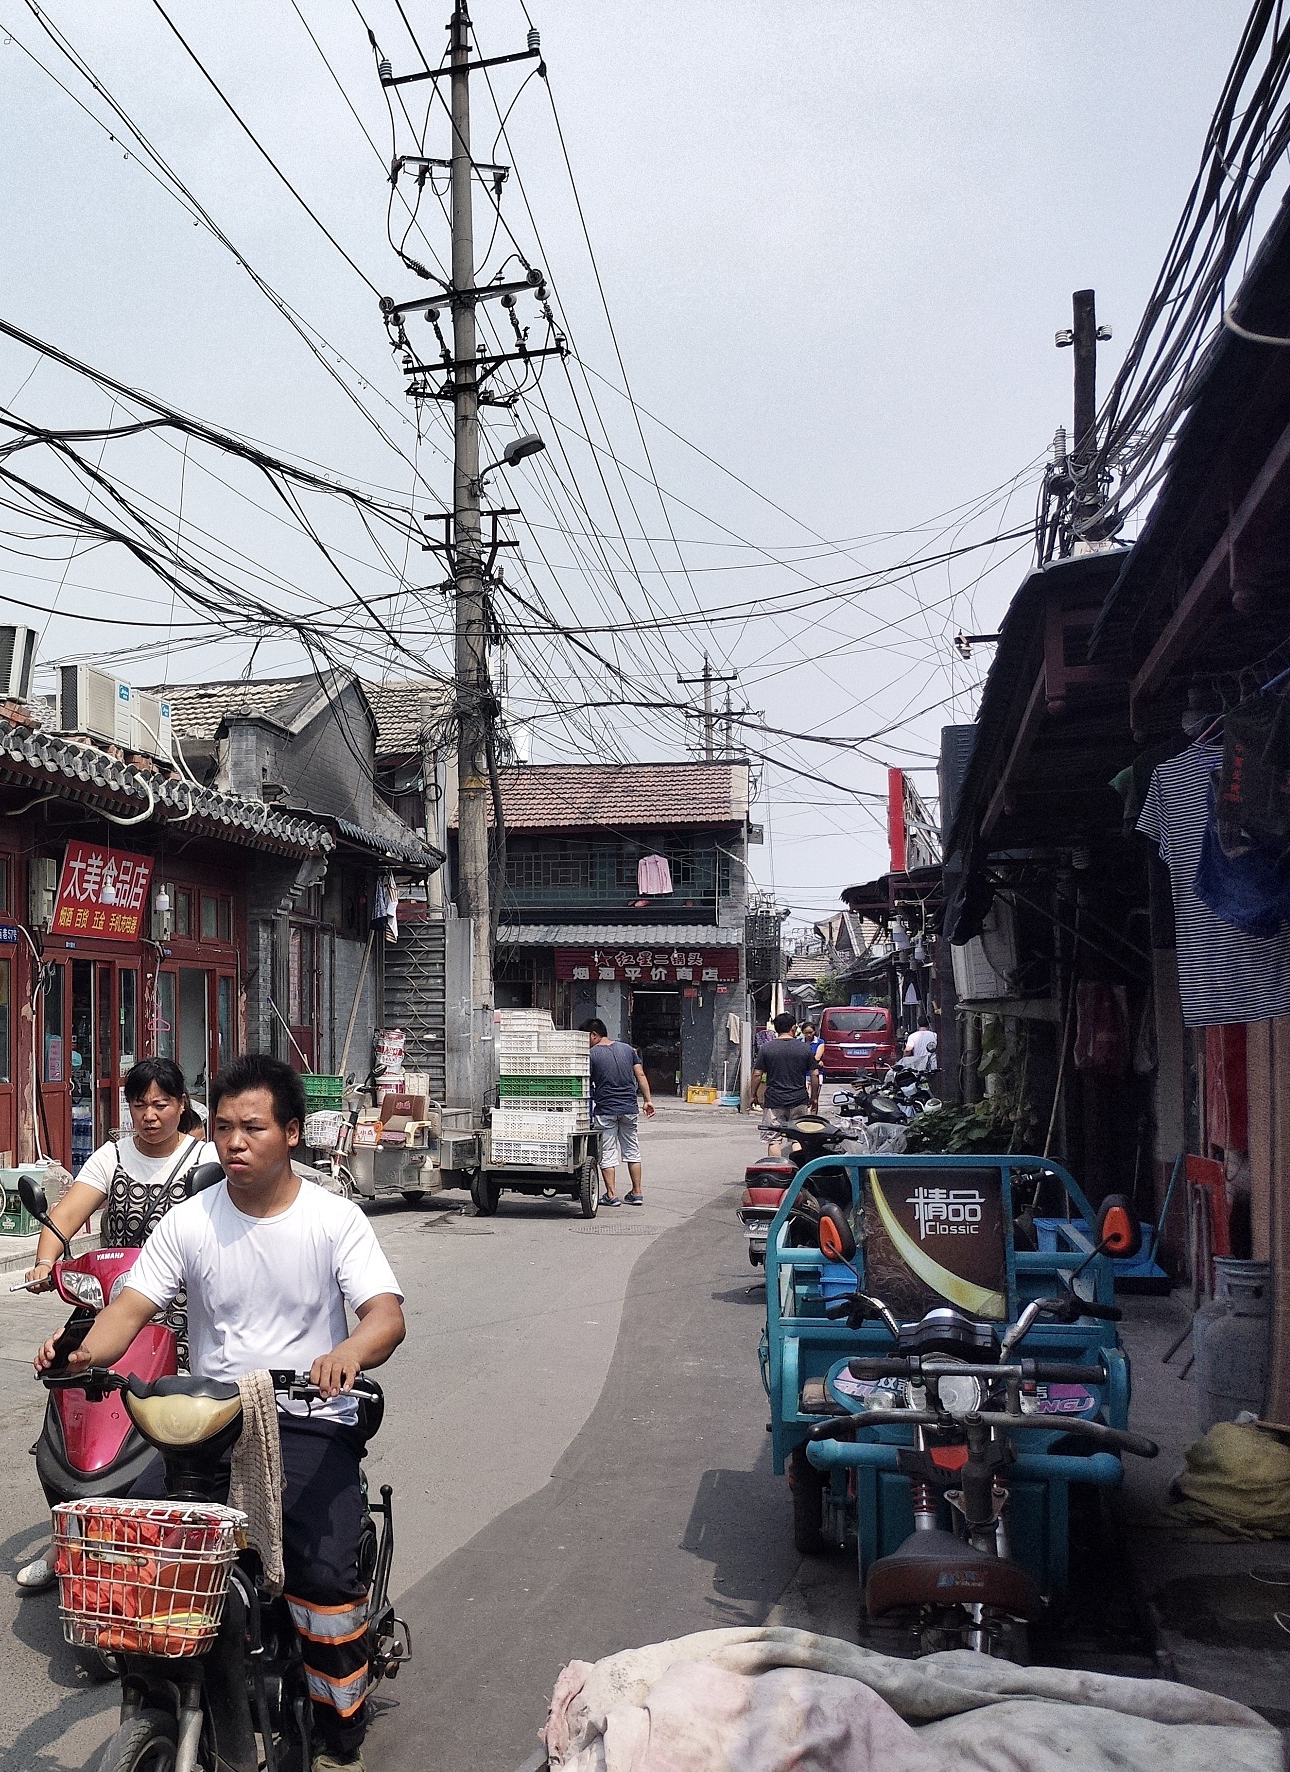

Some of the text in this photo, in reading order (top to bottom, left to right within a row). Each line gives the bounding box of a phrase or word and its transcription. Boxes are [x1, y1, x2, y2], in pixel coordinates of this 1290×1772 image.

[91, 910, 106, 931] 五金
[614, 950, 704, 967] 红星二锅头
[572, 967, 720, 982] 烟酒平价商店
[905, 1186, 986, 1240] 精品
[926, 1222, 979, 1235] Classic
[96, 1252, 125, 1261] YAMAHA
